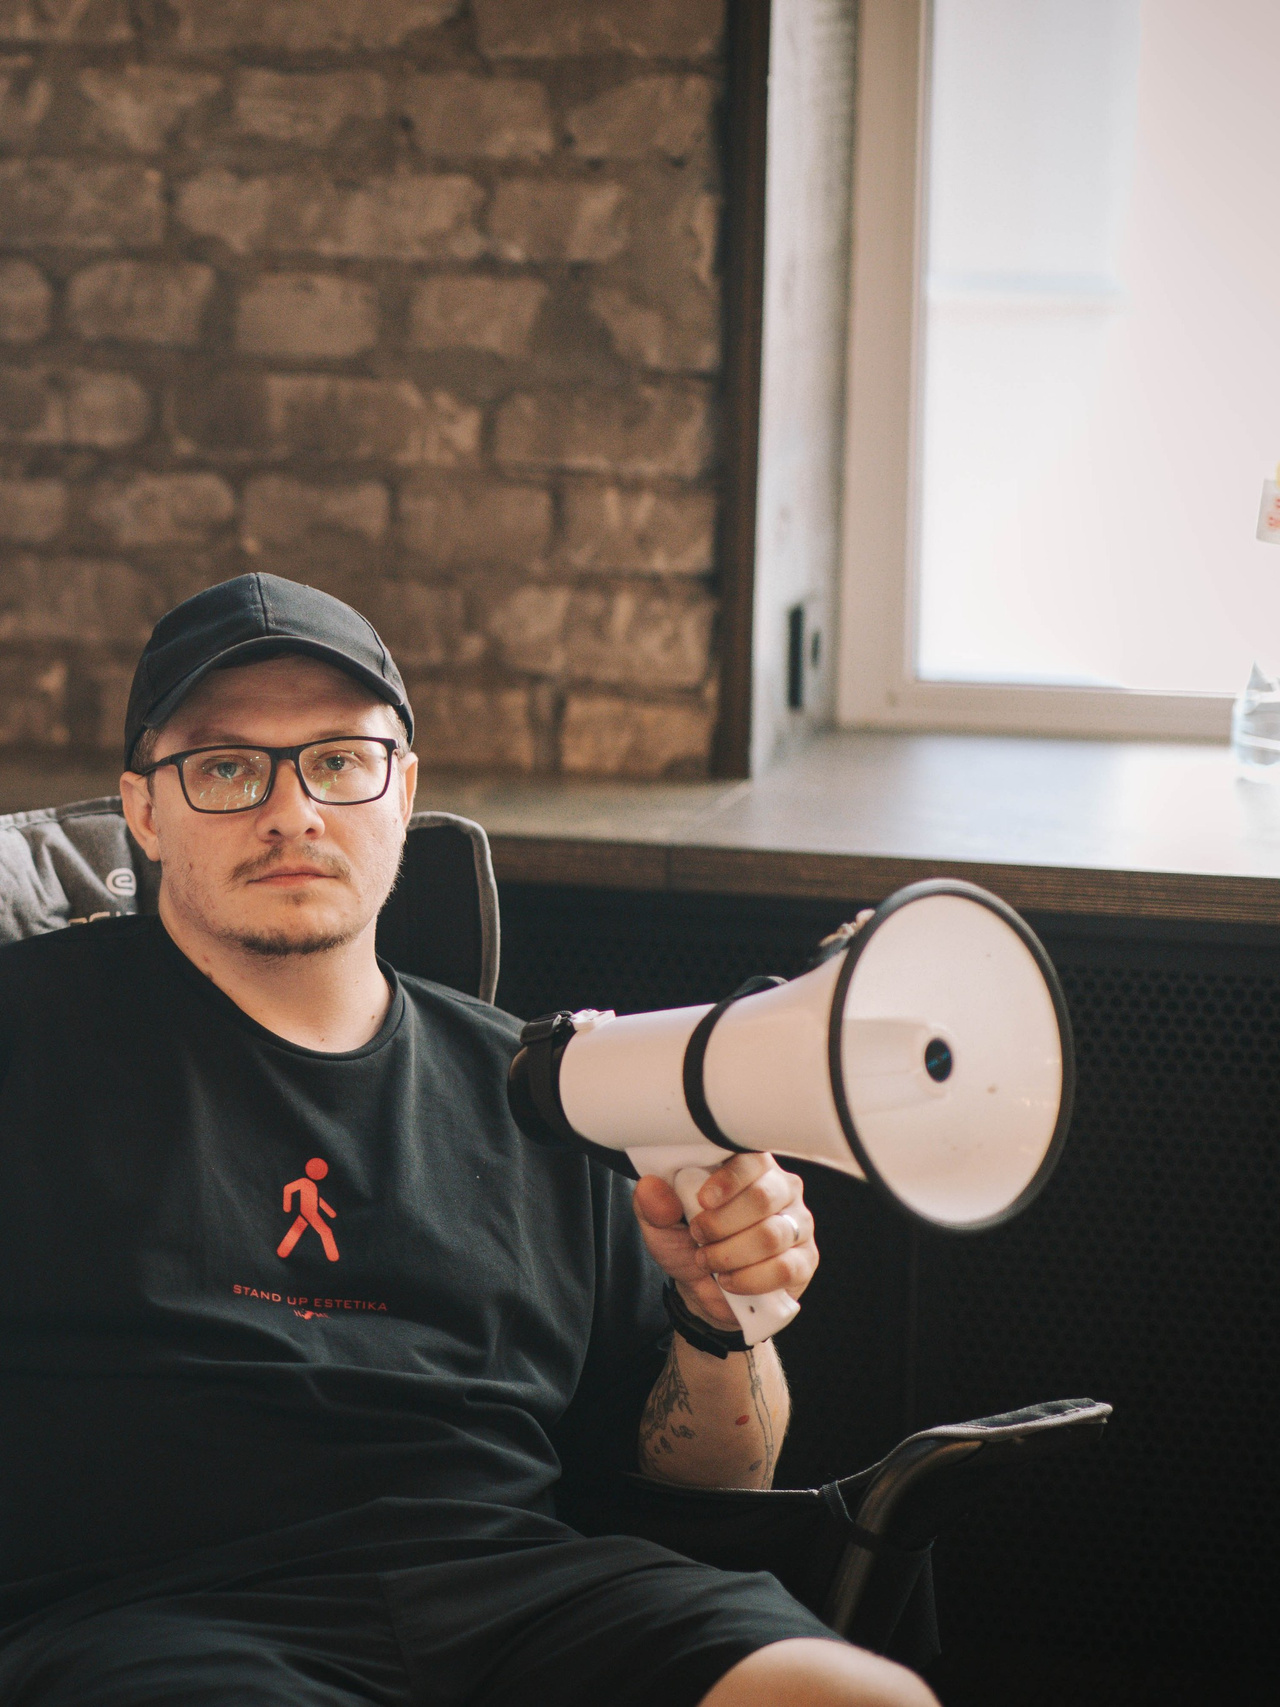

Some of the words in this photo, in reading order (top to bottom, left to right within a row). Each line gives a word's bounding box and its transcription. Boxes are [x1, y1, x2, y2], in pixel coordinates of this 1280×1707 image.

[233, 1284, 282, 1303] STAND
[286, 1295, 309, 1307] UP
[313, 1298, 388, 1312] ESTETIKA
